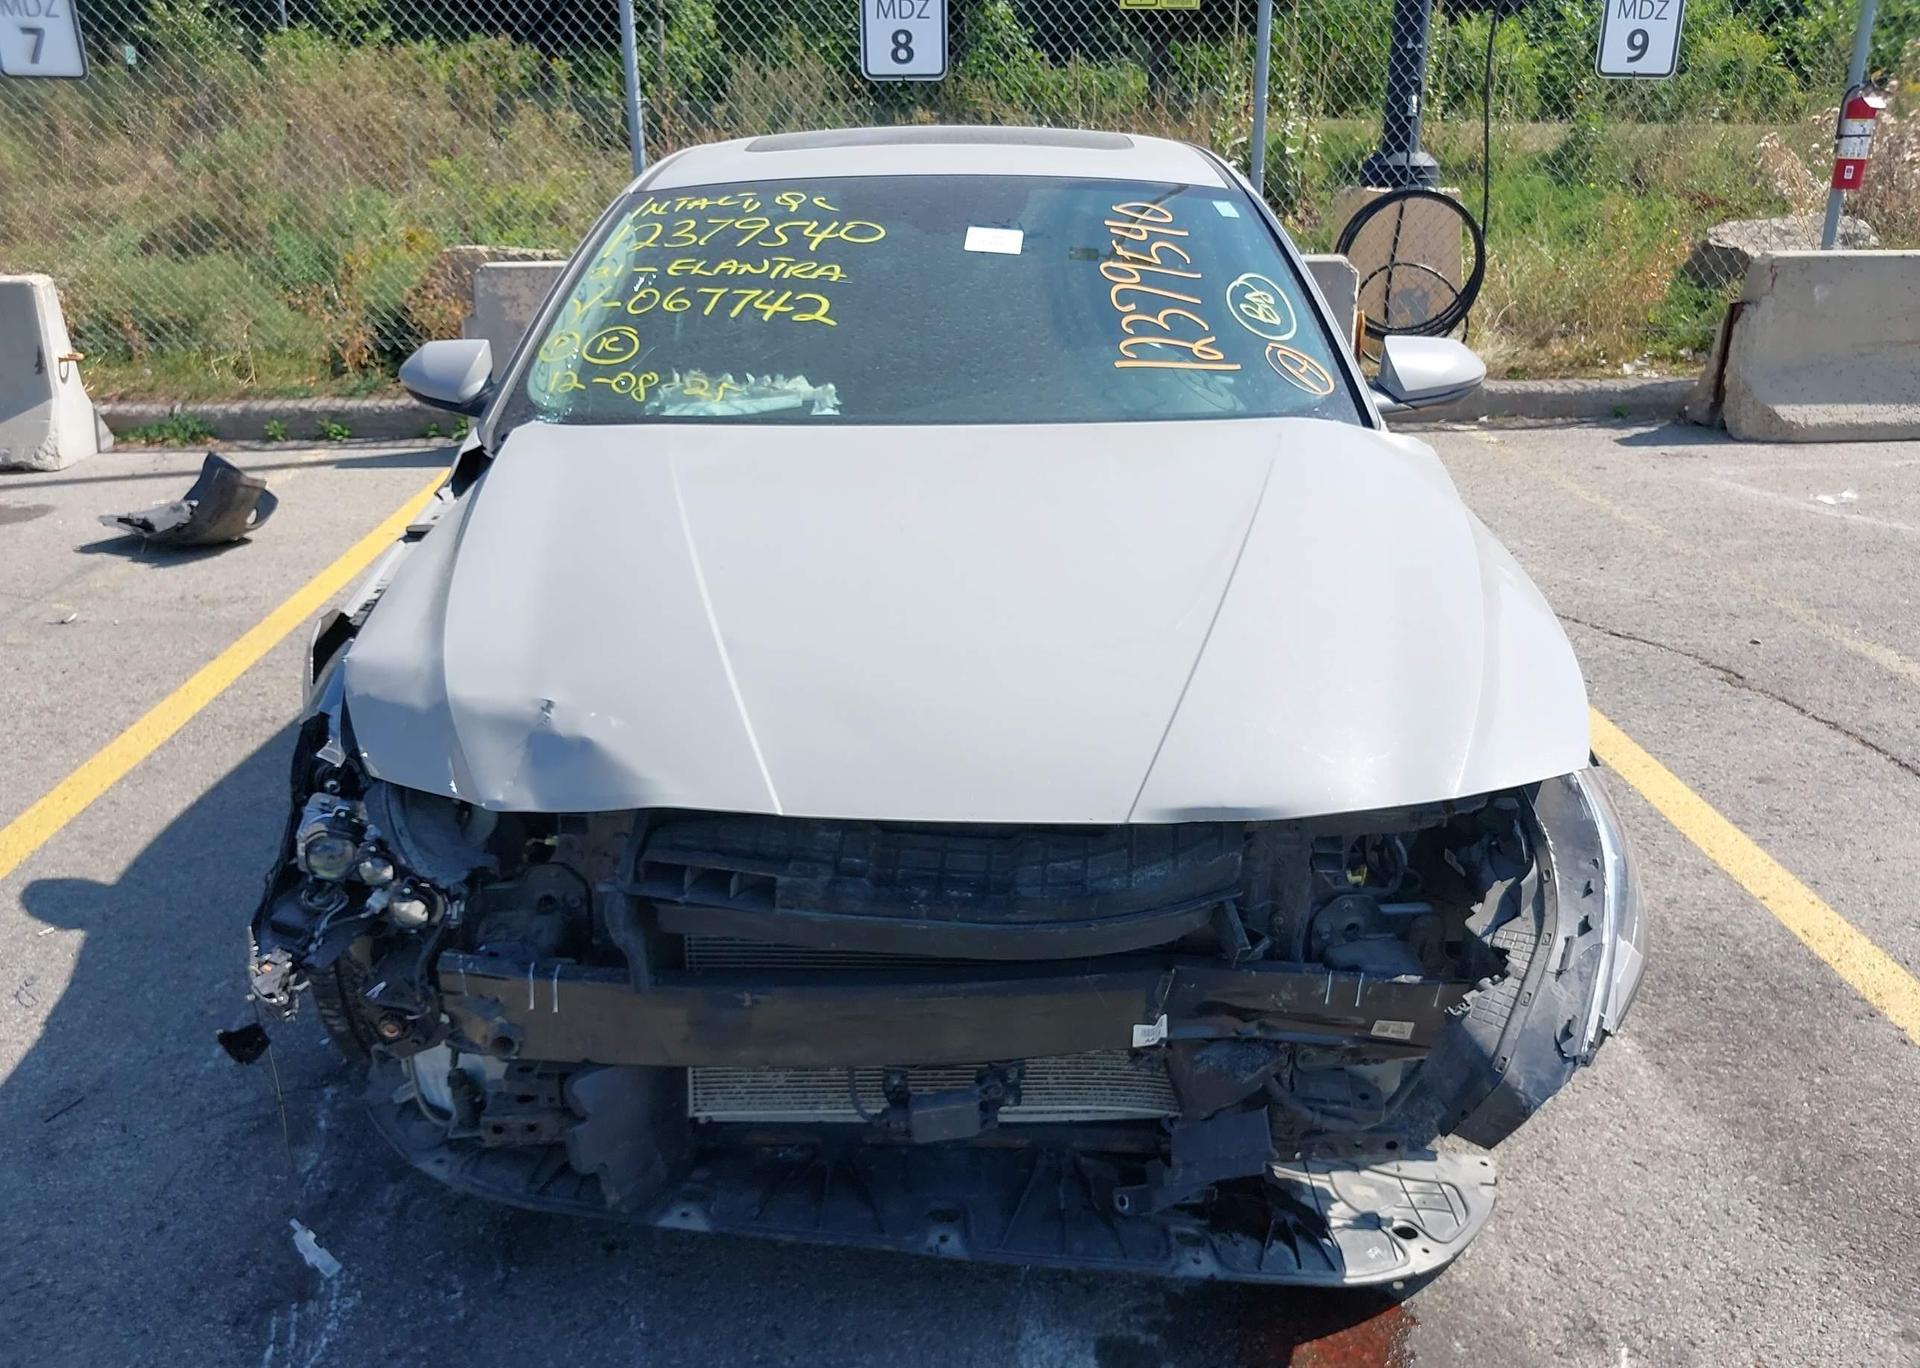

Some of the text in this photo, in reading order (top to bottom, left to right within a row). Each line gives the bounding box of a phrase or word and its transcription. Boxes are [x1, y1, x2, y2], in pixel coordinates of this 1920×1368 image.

[0, 0, 60, 18] MDZ
[876, 0, 930, 19] MDZ
[1617, 0, 1670, 20] MDZ
[20, 26, 45, 65] 7
[890, 29, 914, 65] 8
[1626, 28, 1650, 63] 9
[1099, 201, 1243, 370] 12379540
